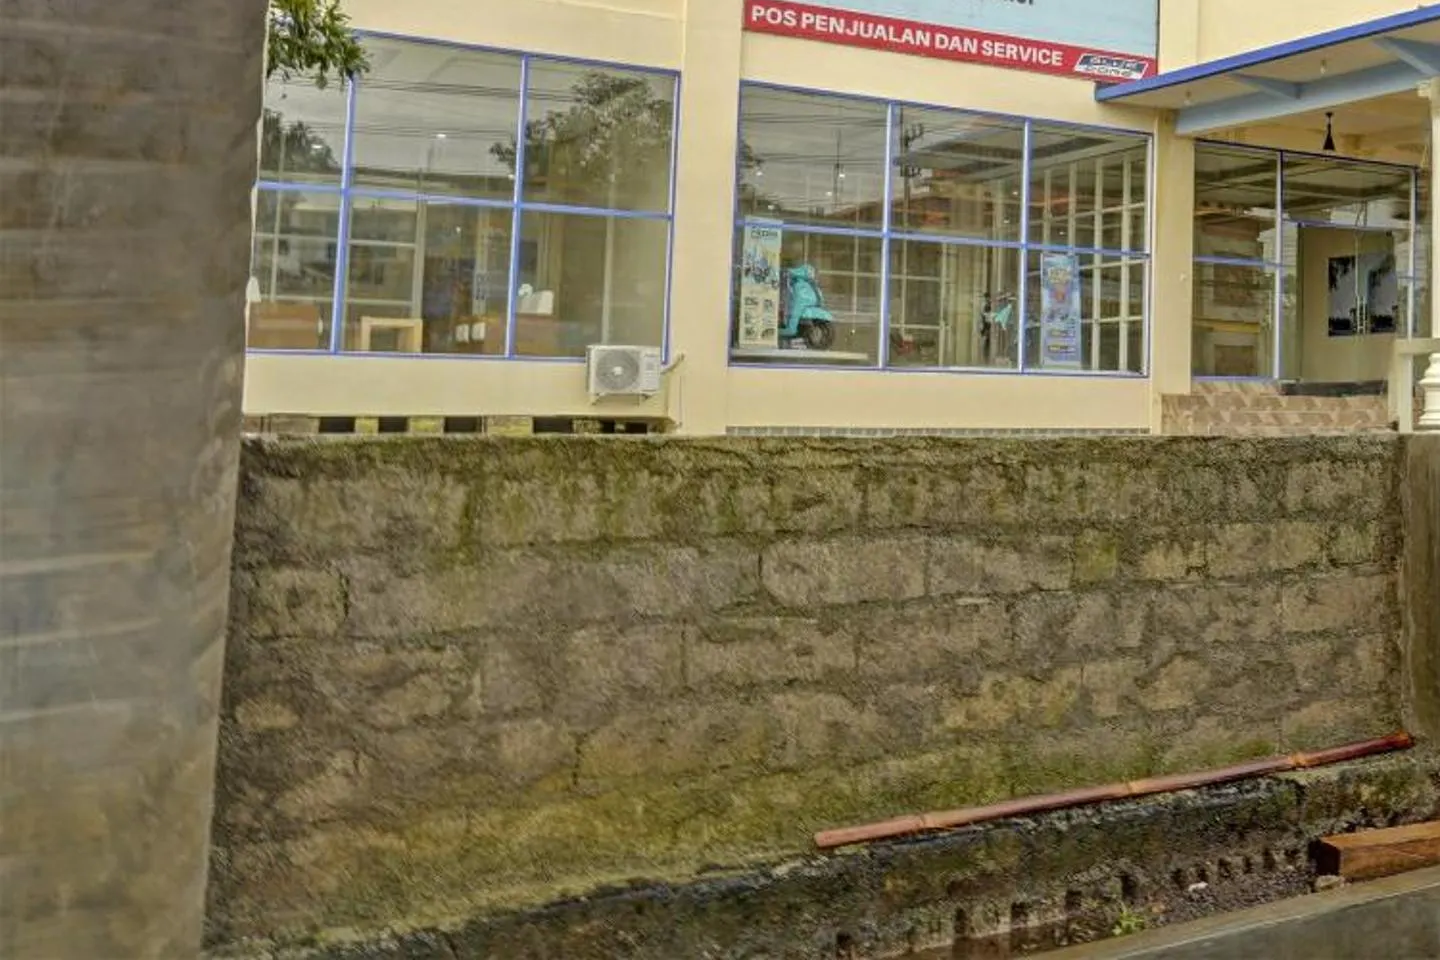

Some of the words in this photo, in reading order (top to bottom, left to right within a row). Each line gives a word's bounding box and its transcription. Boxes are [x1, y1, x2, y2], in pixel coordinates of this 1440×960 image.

[751, 5, 797, 27] POS
[801, 12, 930, 47] PENJUALAN
[934, 31, 978, 54] DAN
[981, 40, 1063, 66] SERVICE
